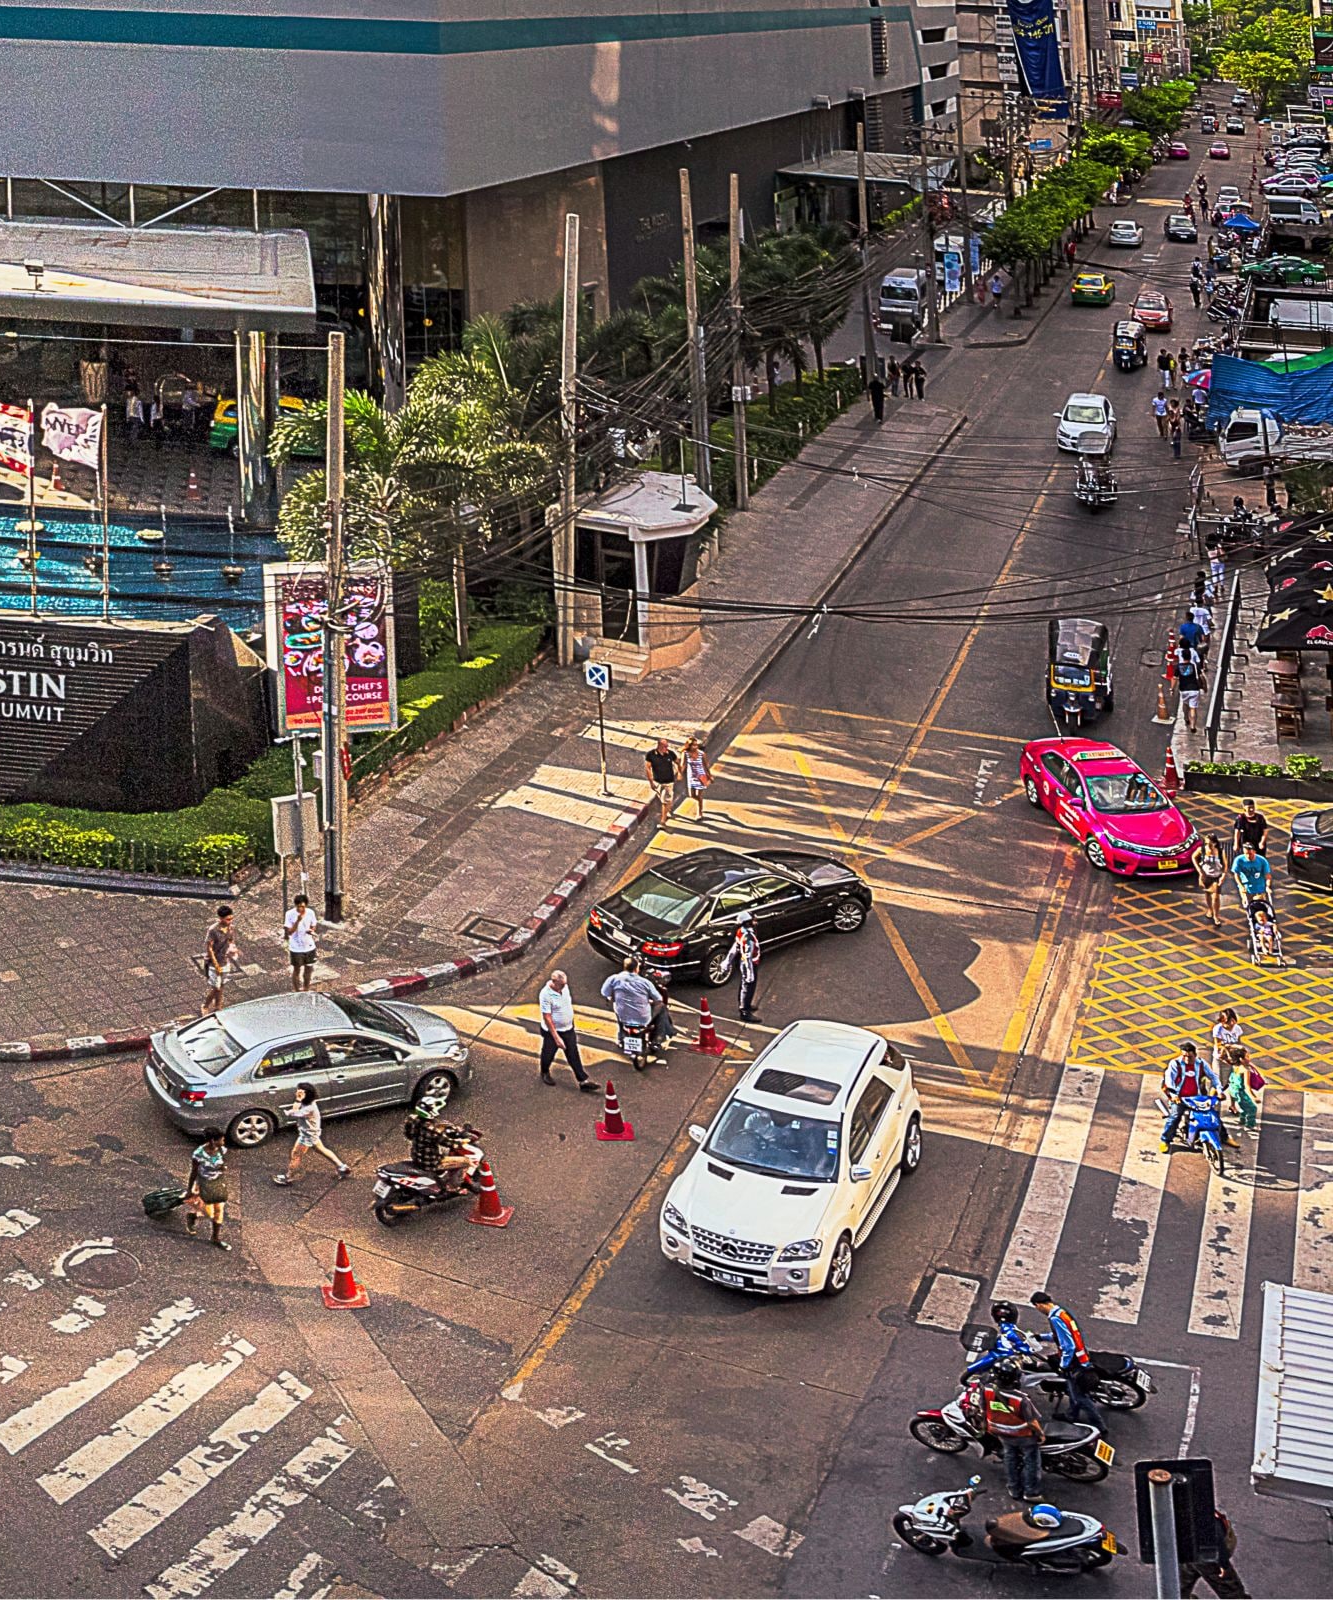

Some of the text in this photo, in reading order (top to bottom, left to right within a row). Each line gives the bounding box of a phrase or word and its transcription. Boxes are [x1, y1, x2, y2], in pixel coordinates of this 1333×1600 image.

[50, 641, 113, 668] สุขุมวิท
[351, 683, 382, 691] CHEF'S
[345, 692, 382, 701] COURSE
